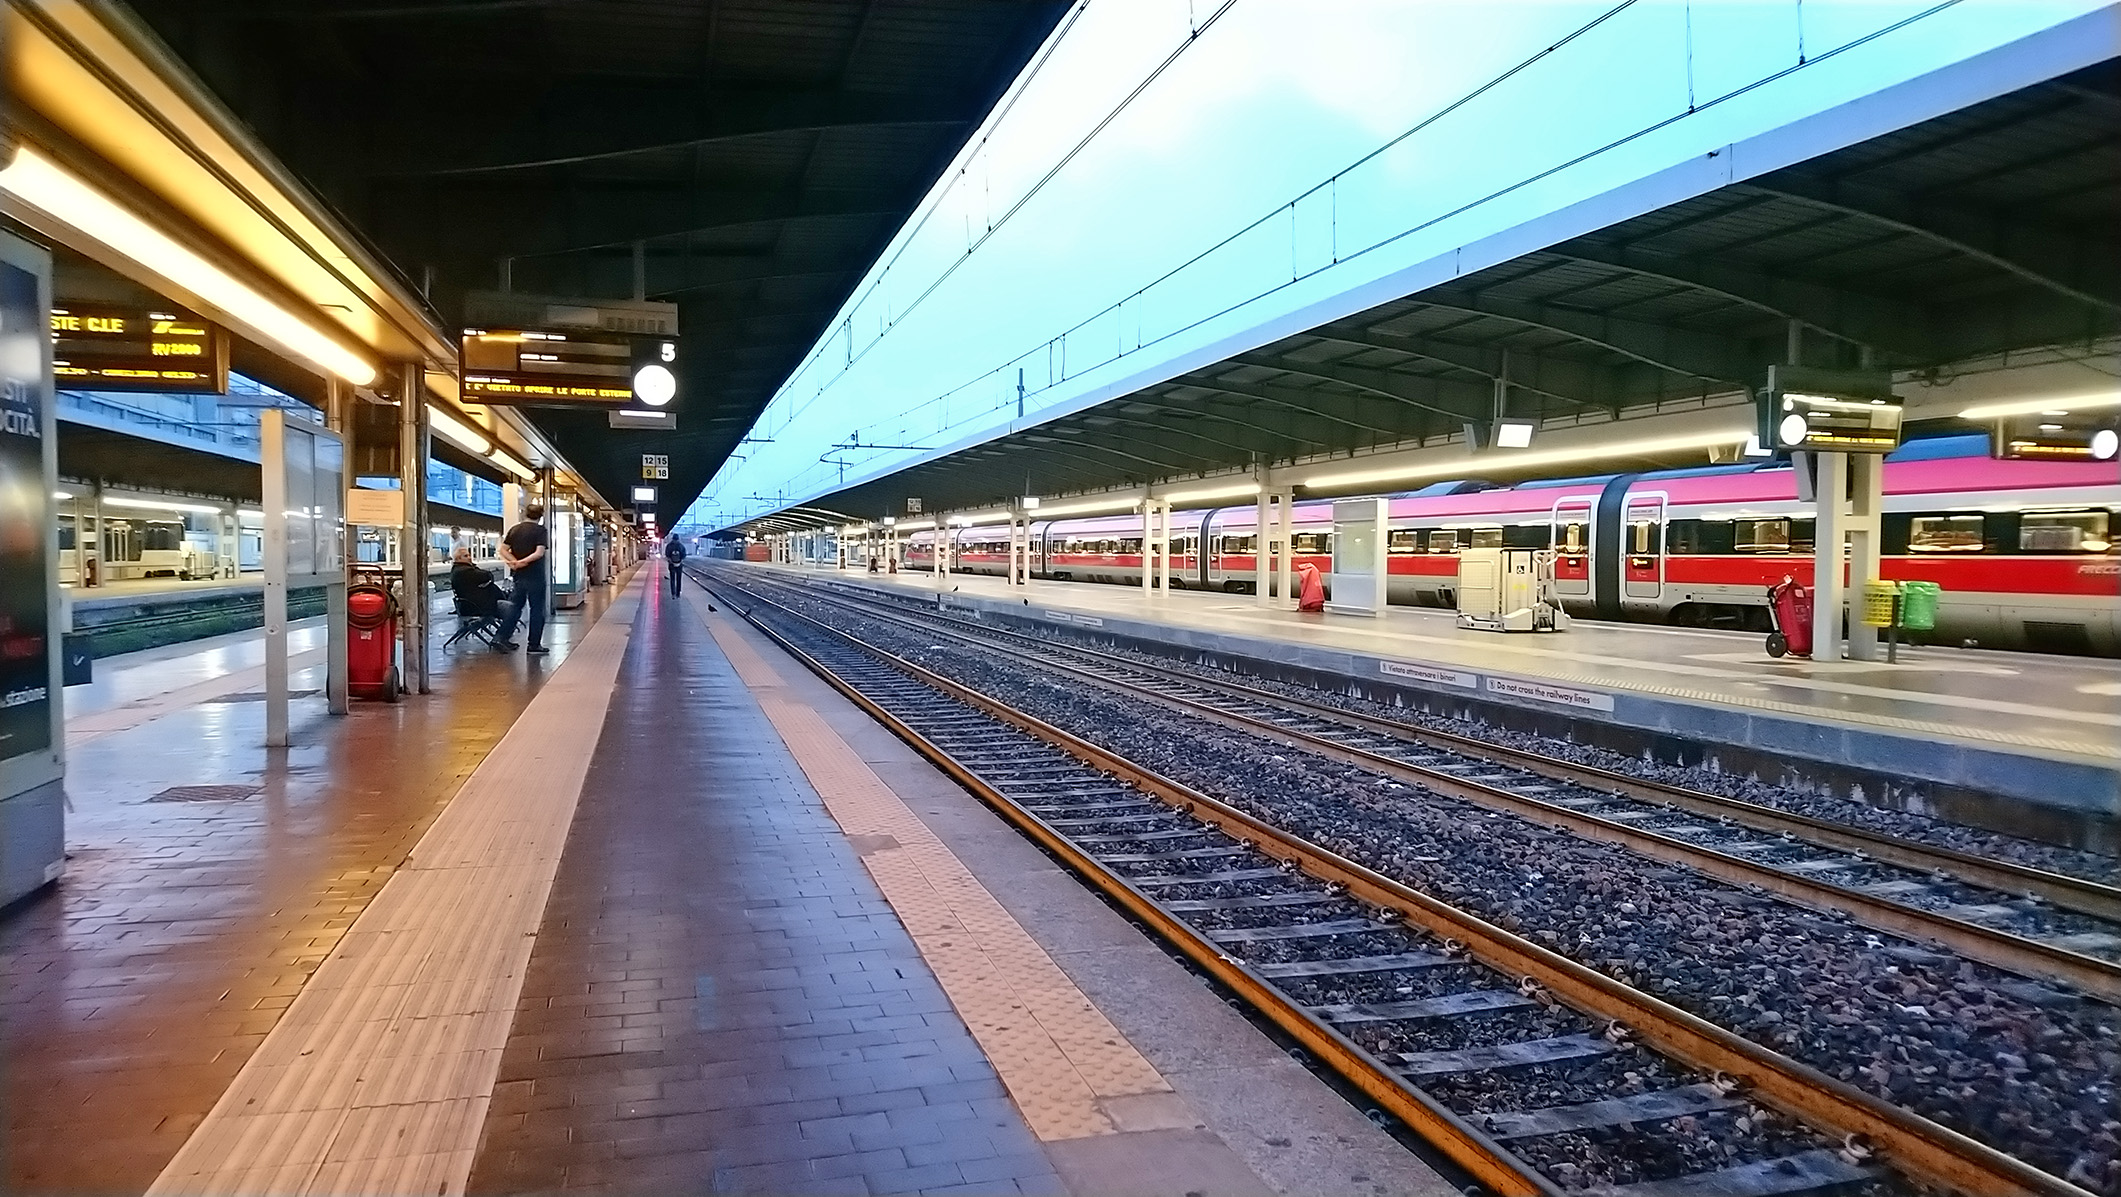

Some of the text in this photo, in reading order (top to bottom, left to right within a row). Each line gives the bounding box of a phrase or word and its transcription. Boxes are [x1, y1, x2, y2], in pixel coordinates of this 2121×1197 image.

[661, 343, 676, 362] 5
[487, 384, 521, 393] VIETATO
[524, 385, 554, 394] APRIRE
[557, 387, 568, 395] LE
[571, 388, 597, 397] PORTE
[644, 456, 668, 465] 12 15
[646, 469, 667, 477] 9 18
[1388, 664, 1406, 674] Vietato
[1406, 668, 1436, 680] attraversare
[1440, 672, 1456, 681] binari
[1497, 681, 1591, 704] Do not cross the railway lines
